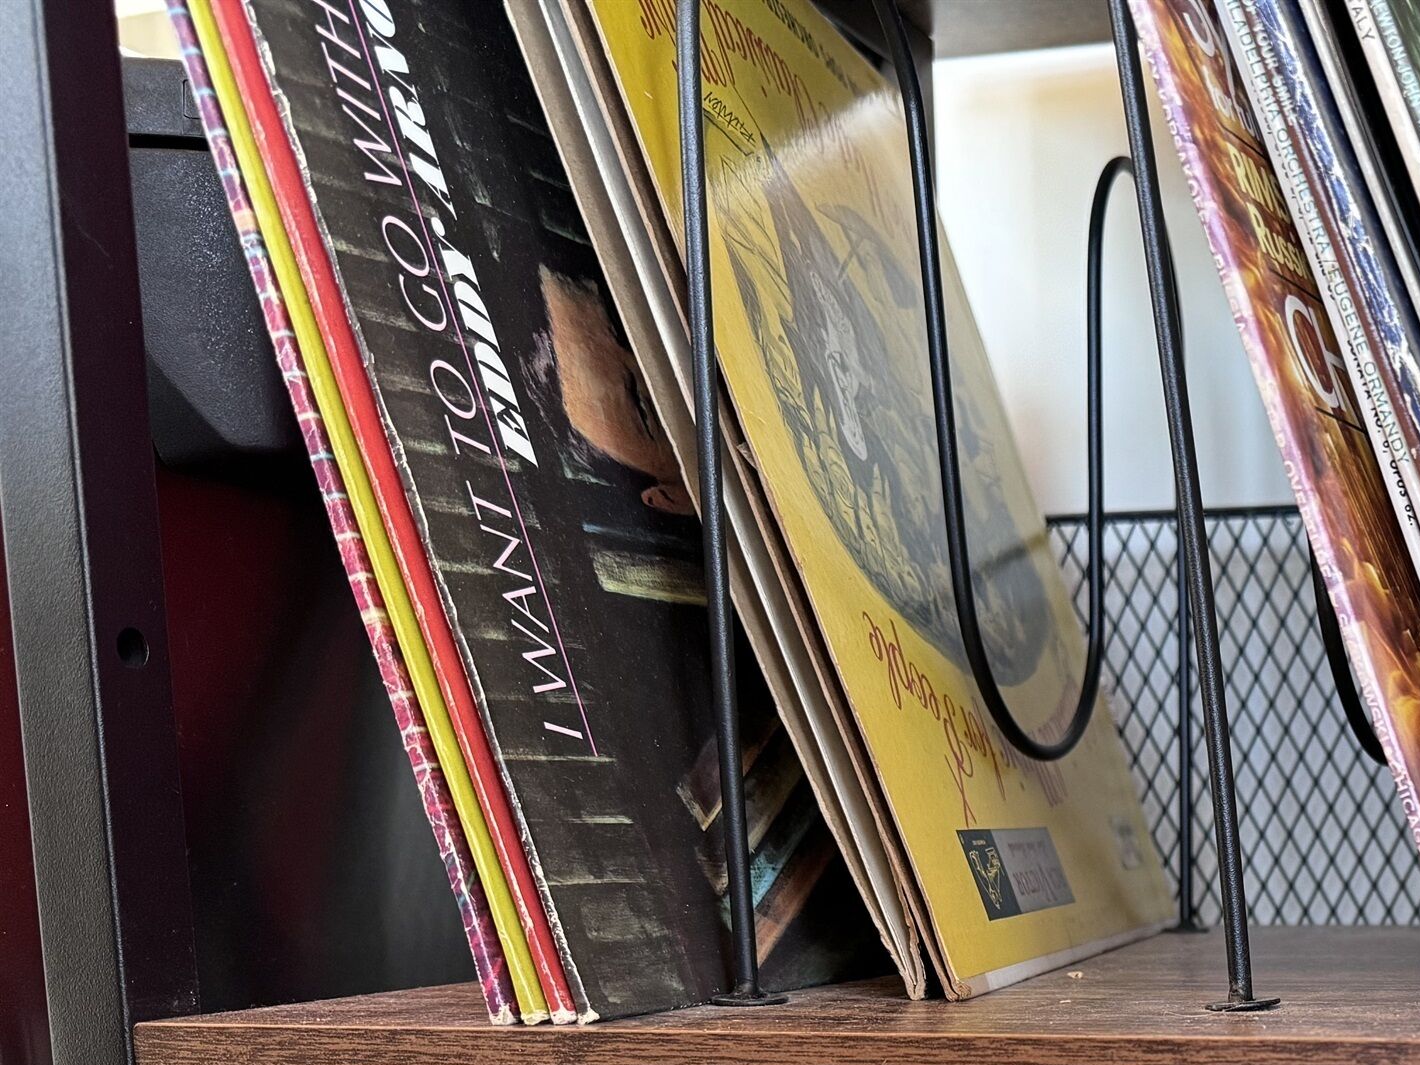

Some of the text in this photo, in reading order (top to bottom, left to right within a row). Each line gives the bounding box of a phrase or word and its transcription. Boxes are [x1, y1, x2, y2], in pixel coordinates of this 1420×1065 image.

[311, 0, 403, 186] WITH
[1350, 6, 1376, 40] ALY
[358, 0, 539, 468] EDDY ARNO
[1225, 142, 1292, 225] RIMS
[381, 215, 447, 331] GO
[1275, 127, 1332, 255] ORCHESTRA
[1328, 264, 1370, 352] EUGENE
[1363, 361, 1411, 463] ORMANDY
[430, 359, 492, 455] TO
[465, 480, 567, 693] WANT
